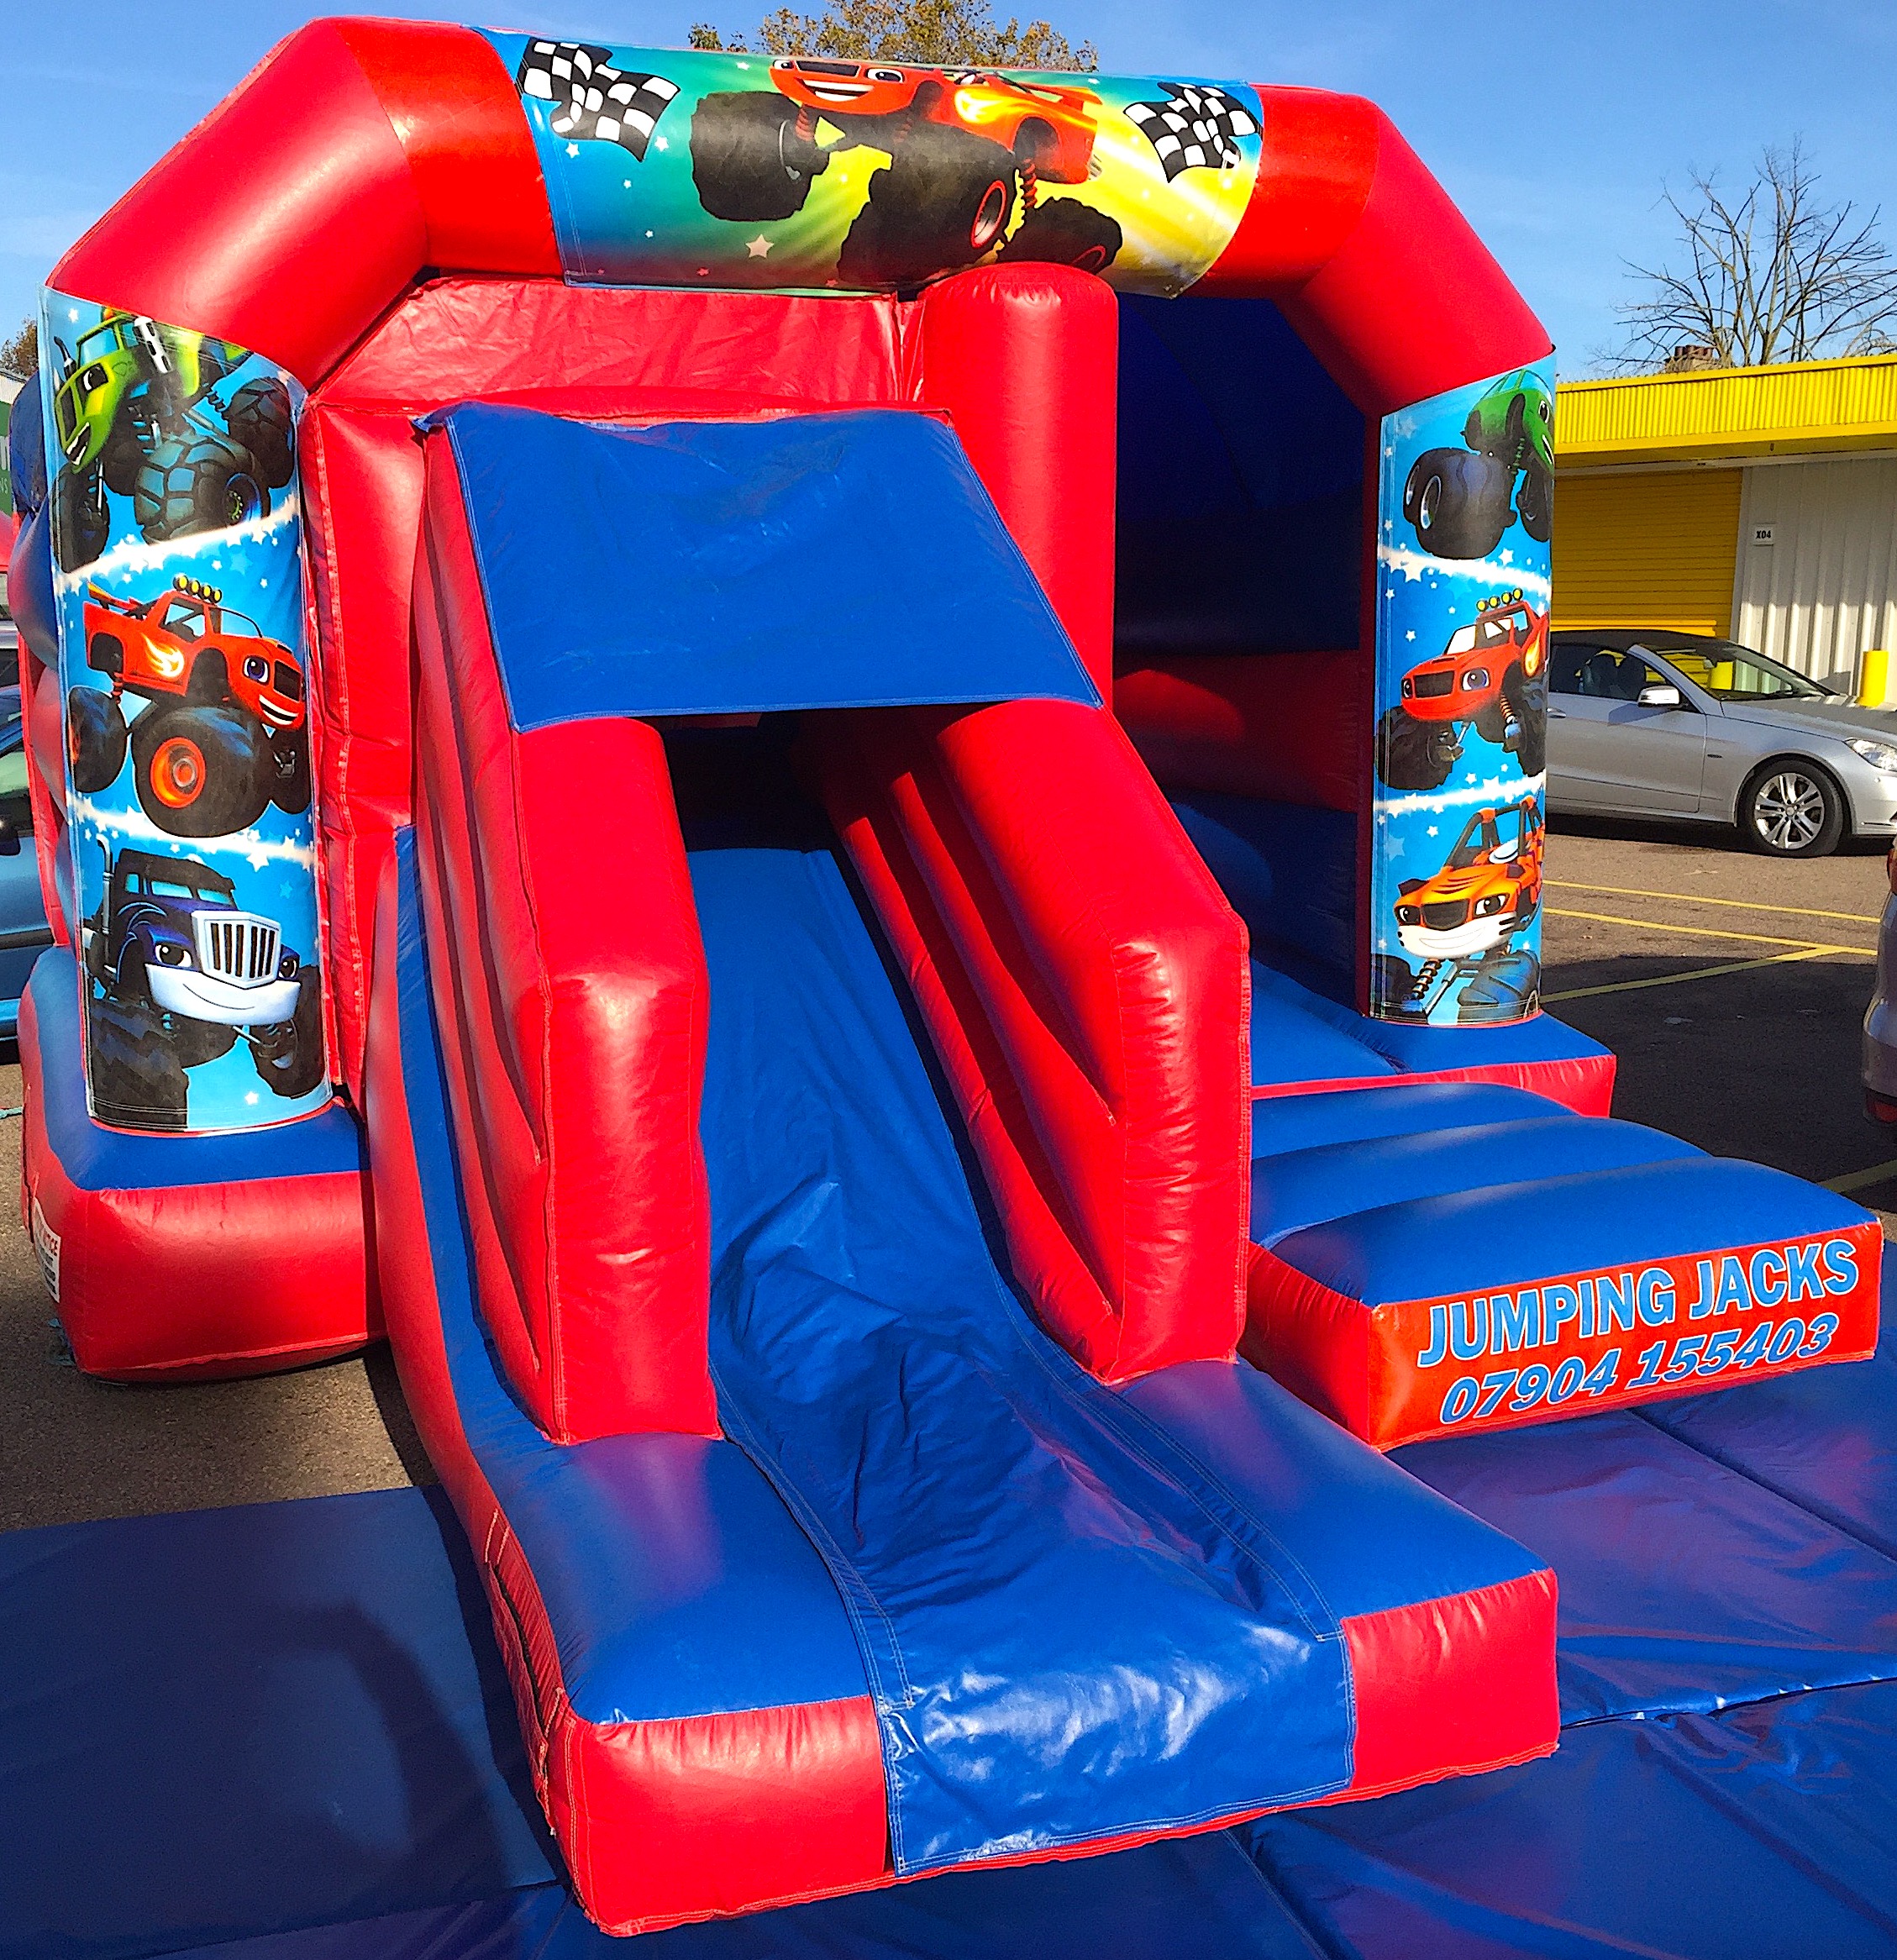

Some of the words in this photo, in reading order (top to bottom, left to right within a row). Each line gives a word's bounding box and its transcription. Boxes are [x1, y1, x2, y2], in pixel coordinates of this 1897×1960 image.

[1756, 529, 1772, 539] X04
[1417, 1267, 1675, 1368] JUMPING
[1689, 1239, 1858, 1320] JACKS
[1439, 1348, 1621, 1424] 07904
[1624, 1312, 1839, 1390] 155403
